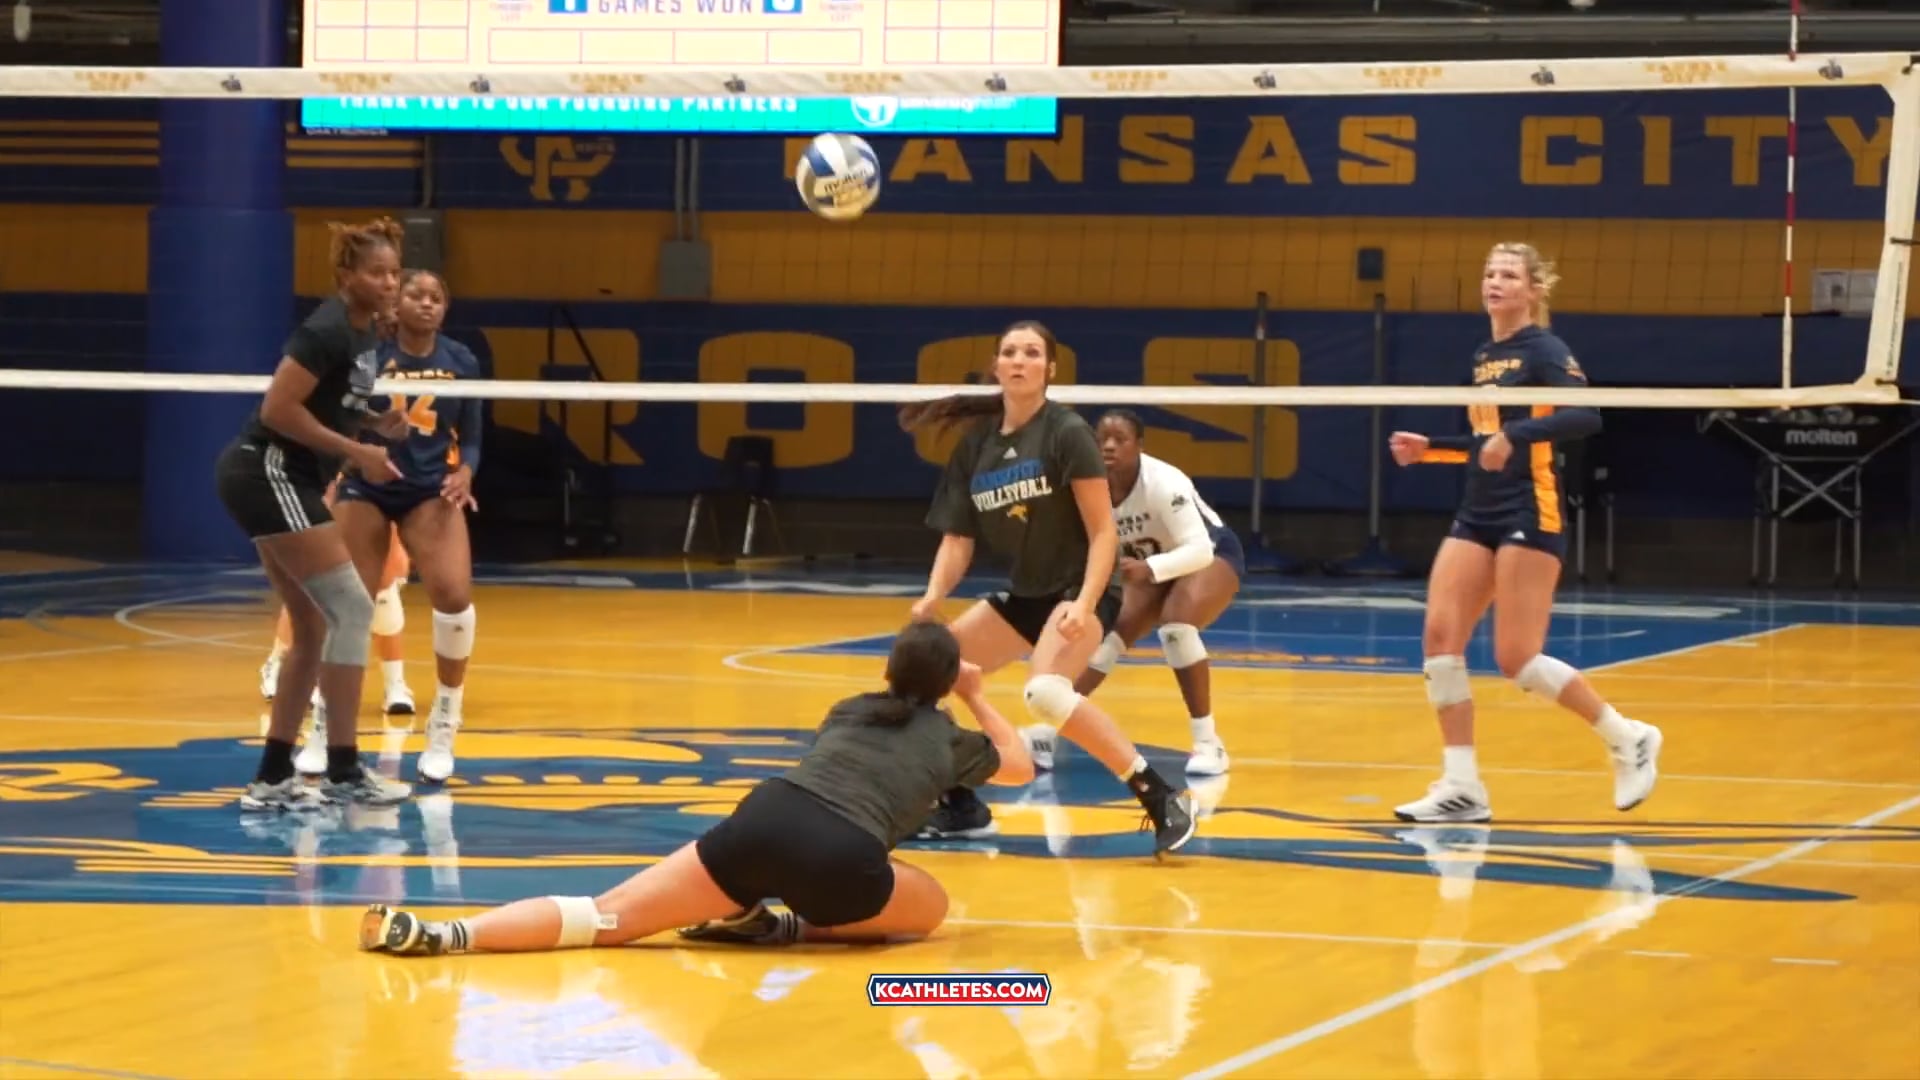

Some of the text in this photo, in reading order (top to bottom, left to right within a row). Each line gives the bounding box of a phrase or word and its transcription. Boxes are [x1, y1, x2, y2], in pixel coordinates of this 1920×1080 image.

[599, 0, 682, 13] GAMES
[697, 0, 752, 13] WON
[1520, 115, 1894, 187] CITY
[1785, 428, 1858, 445] molten
[971, 475, 1053, 513] VOLLEYBALL
